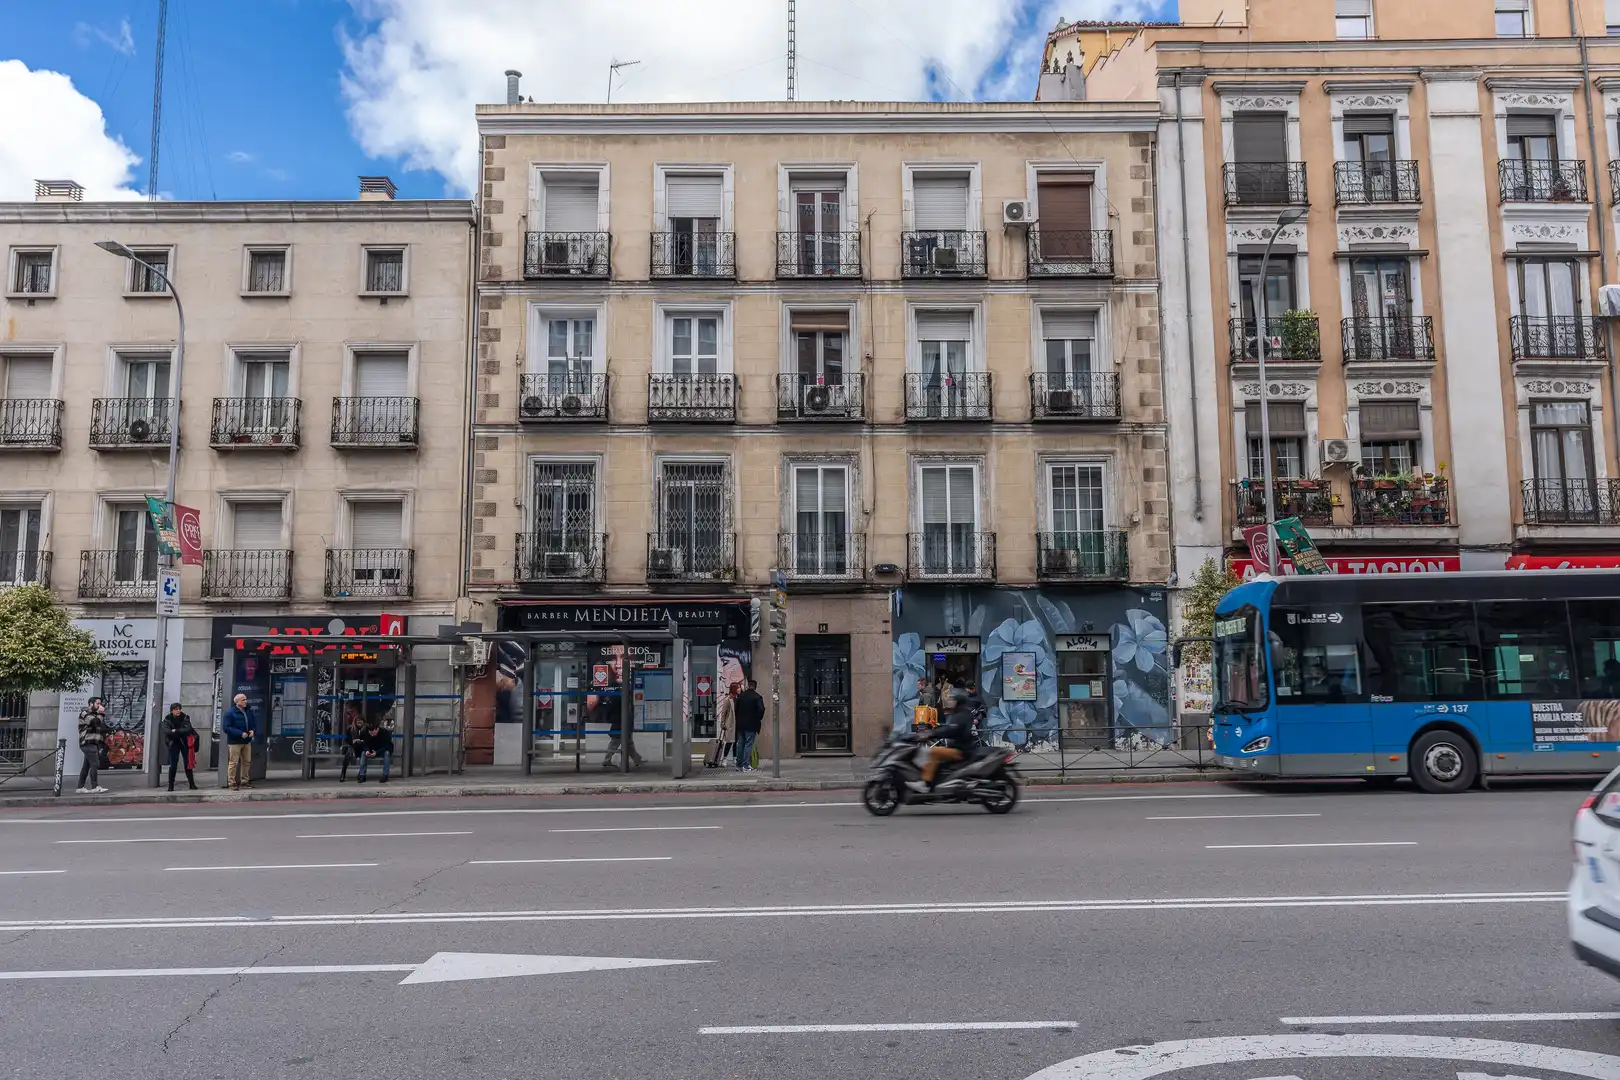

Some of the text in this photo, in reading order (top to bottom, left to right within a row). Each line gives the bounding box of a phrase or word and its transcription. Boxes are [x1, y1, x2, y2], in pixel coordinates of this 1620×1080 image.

[527, 608, 720, 622] BARBER MENDIETA BEAUTY
[91, 640, 133, 649] ARISOL
[936, 638, 968, 651] ALOHA
[1066, 636, 1098, 650] ALOHA
[601, 646, 650, 656] SERVCIOS
[1452, 704, 1469, 713] 137
[1532, 703, 1563, 712] NUESTRA
[1533, 712, 1583, 722] FAMILIA CRECE
